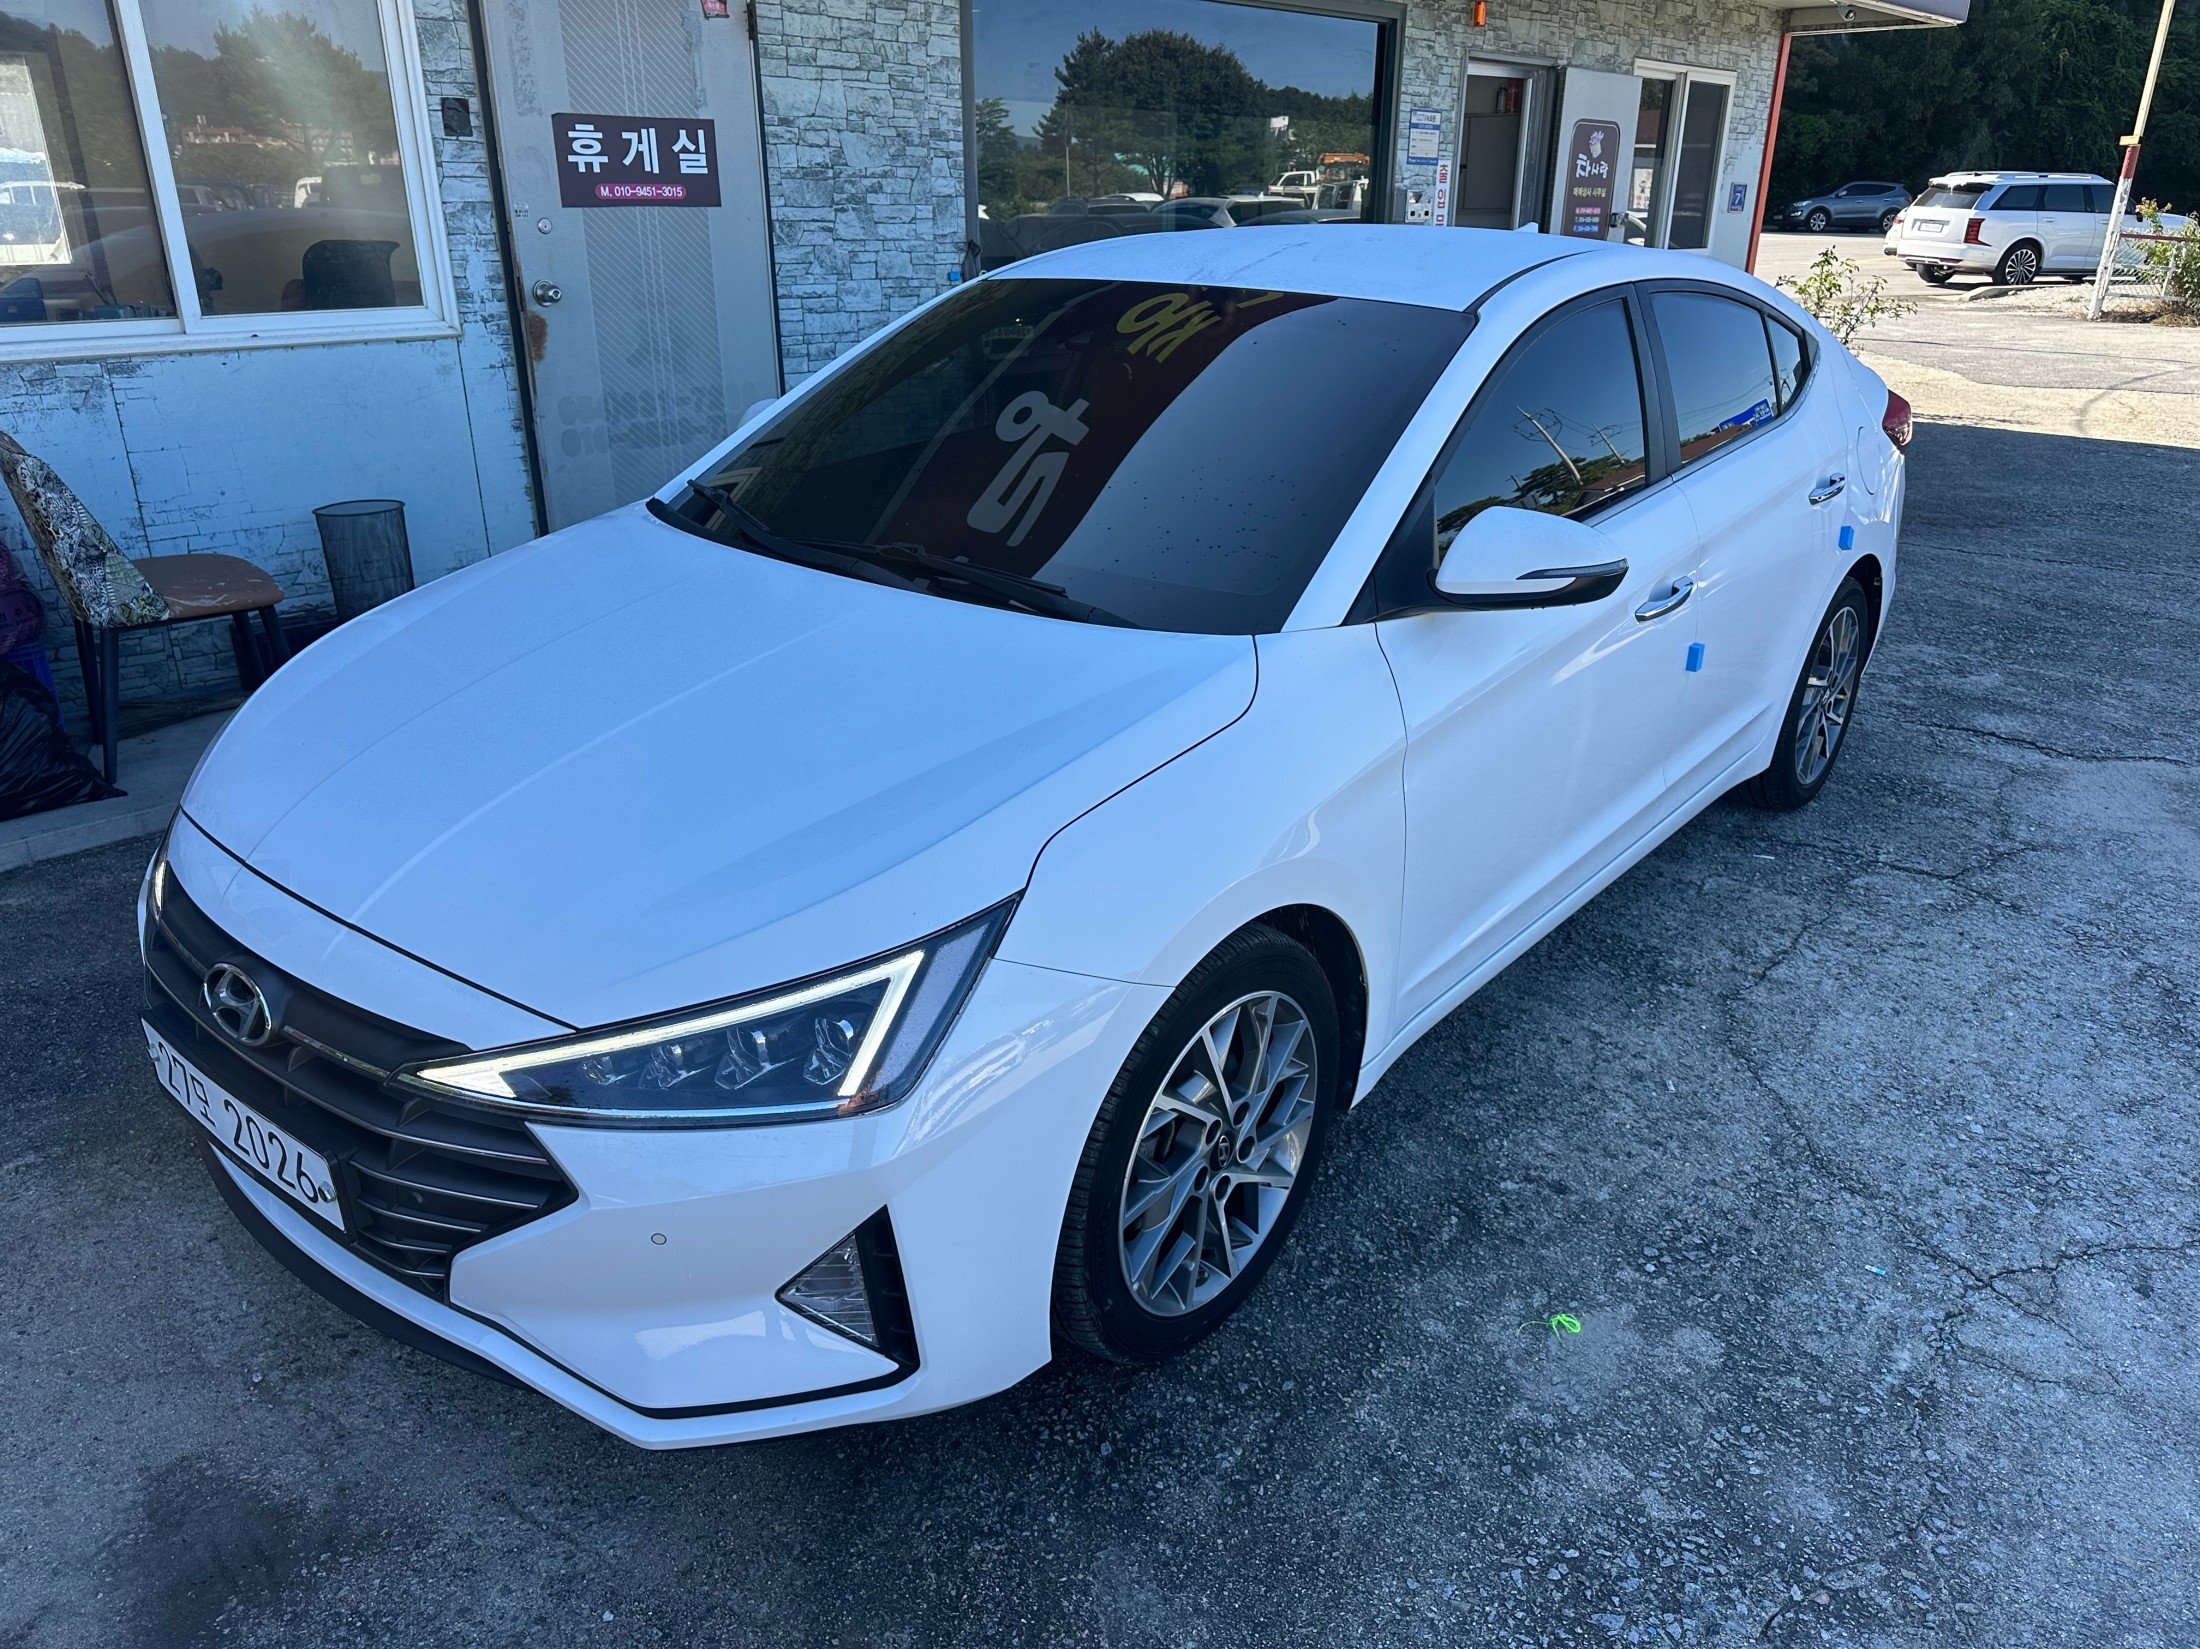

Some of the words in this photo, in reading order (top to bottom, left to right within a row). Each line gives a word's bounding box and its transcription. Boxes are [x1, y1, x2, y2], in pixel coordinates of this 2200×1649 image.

[567, 123, 709, 175] 휴게실
[600, 186, 613, 197] M.
[614, 186, 683, 197] 010-9451-3015
[1734, 192, 1742, 205] 7
[158, 1041, 217, 1128] 27모
[223, 1098, 319, 1204] 2026
